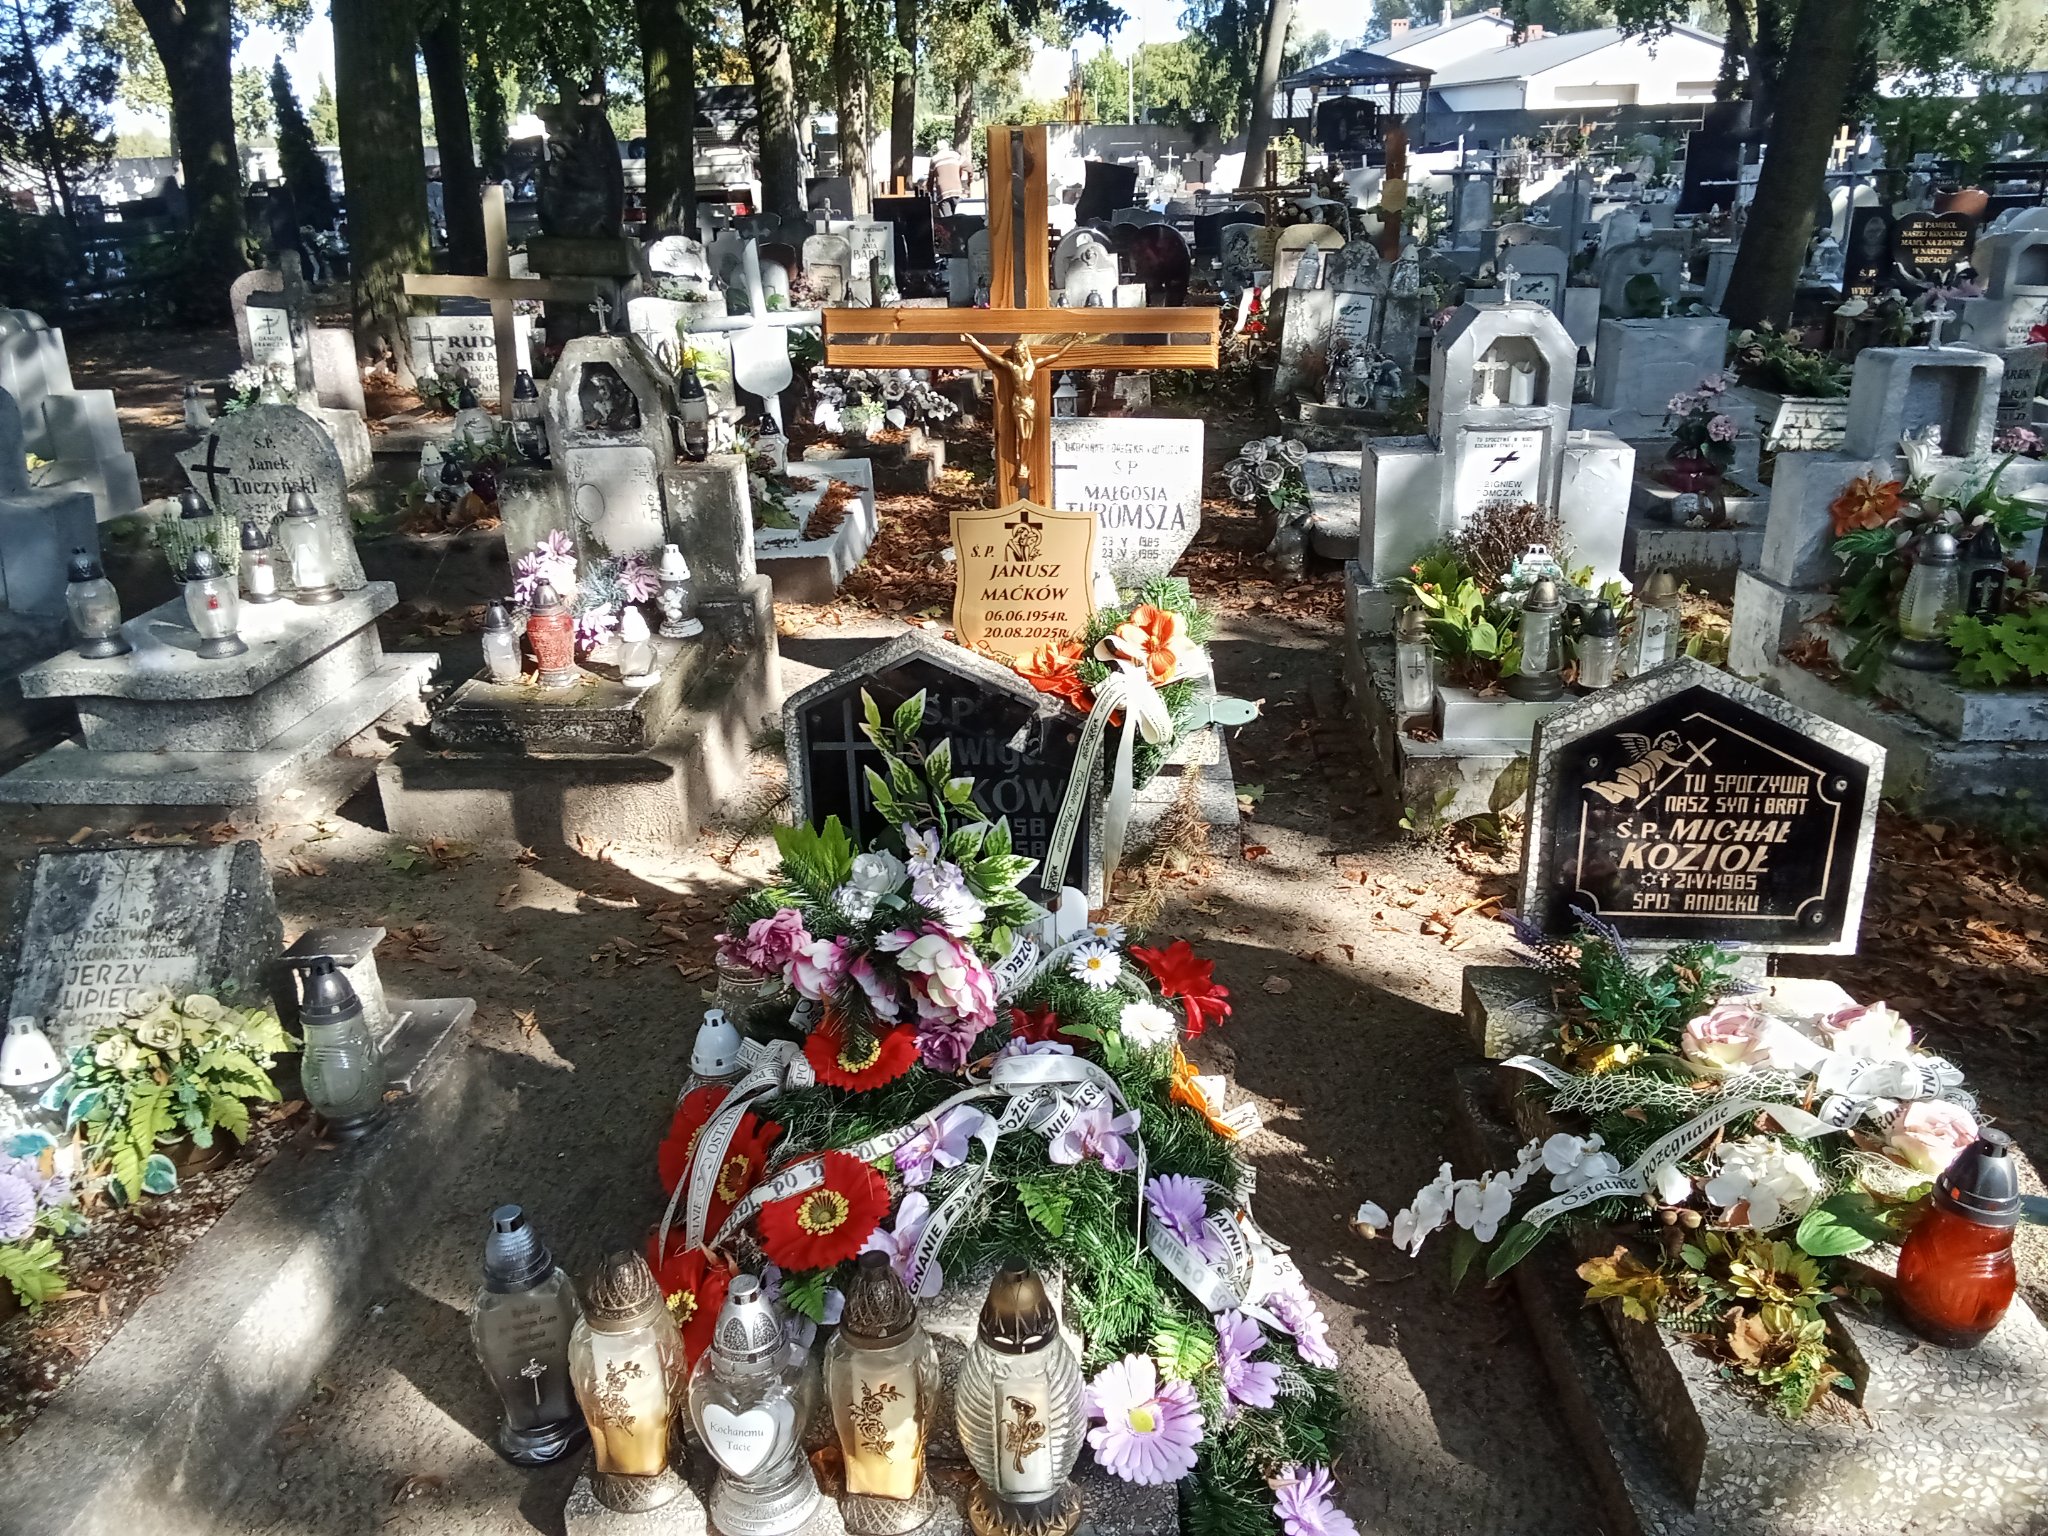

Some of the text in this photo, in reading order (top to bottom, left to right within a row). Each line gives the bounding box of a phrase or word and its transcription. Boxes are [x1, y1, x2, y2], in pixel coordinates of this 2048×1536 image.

[989, 564, 1061, 581] JANUSZ
[980, 584, 1070, 601] MAĆKÓW
[1684, 773, 1809, 795] TU SPOCZYWA
[1664, 795, 1709, 813] NASZ
[1715, 796, 1748, 814] SYN
[1764, 797, 1810, 815] BRAT
[1669, 818, 1792, 843] MICHAŁ
[1619, 842, 1770, 873] KOZIOŁ
[1683, 893, 1760, 912] ANIOŁKU
[66, 963, 147, 986] JERZY
[1561, 1177, 1640, 1207] Ostatnie
[710, 1421, 764, 1438] Kochanemu
[726, 1440, 751, 1452] Tacie
